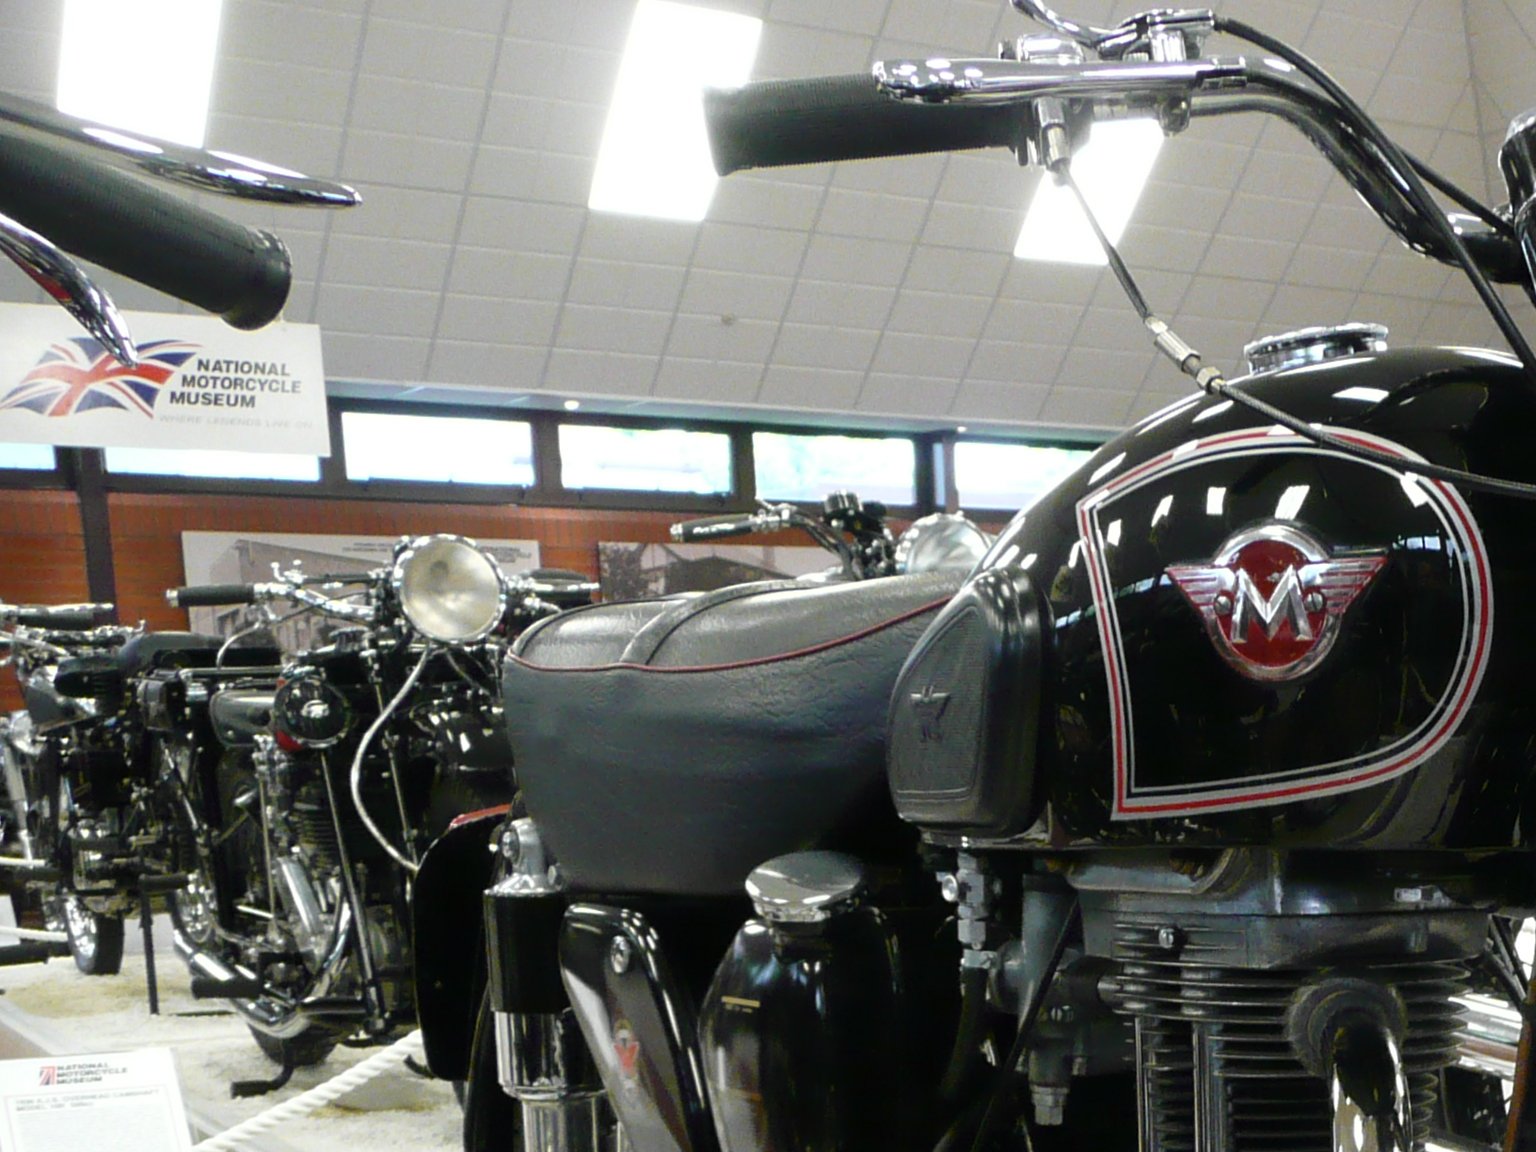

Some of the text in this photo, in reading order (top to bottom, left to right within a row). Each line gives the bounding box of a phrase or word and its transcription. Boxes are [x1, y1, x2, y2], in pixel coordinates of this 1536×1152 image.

[197, 358, 291, 377] NATIONAL
[181, 375, 302, 394] MOTORCYCLE
[169, 391, 256, 409] MUSEUM
[1231, 564, 1313, 643] M
[57, 1062, 109, 1071] NATIONAL
[57, 1067, 128, 1078] MOTORCYCLE
[57, 1076, 102, 1085] MUSEUM
